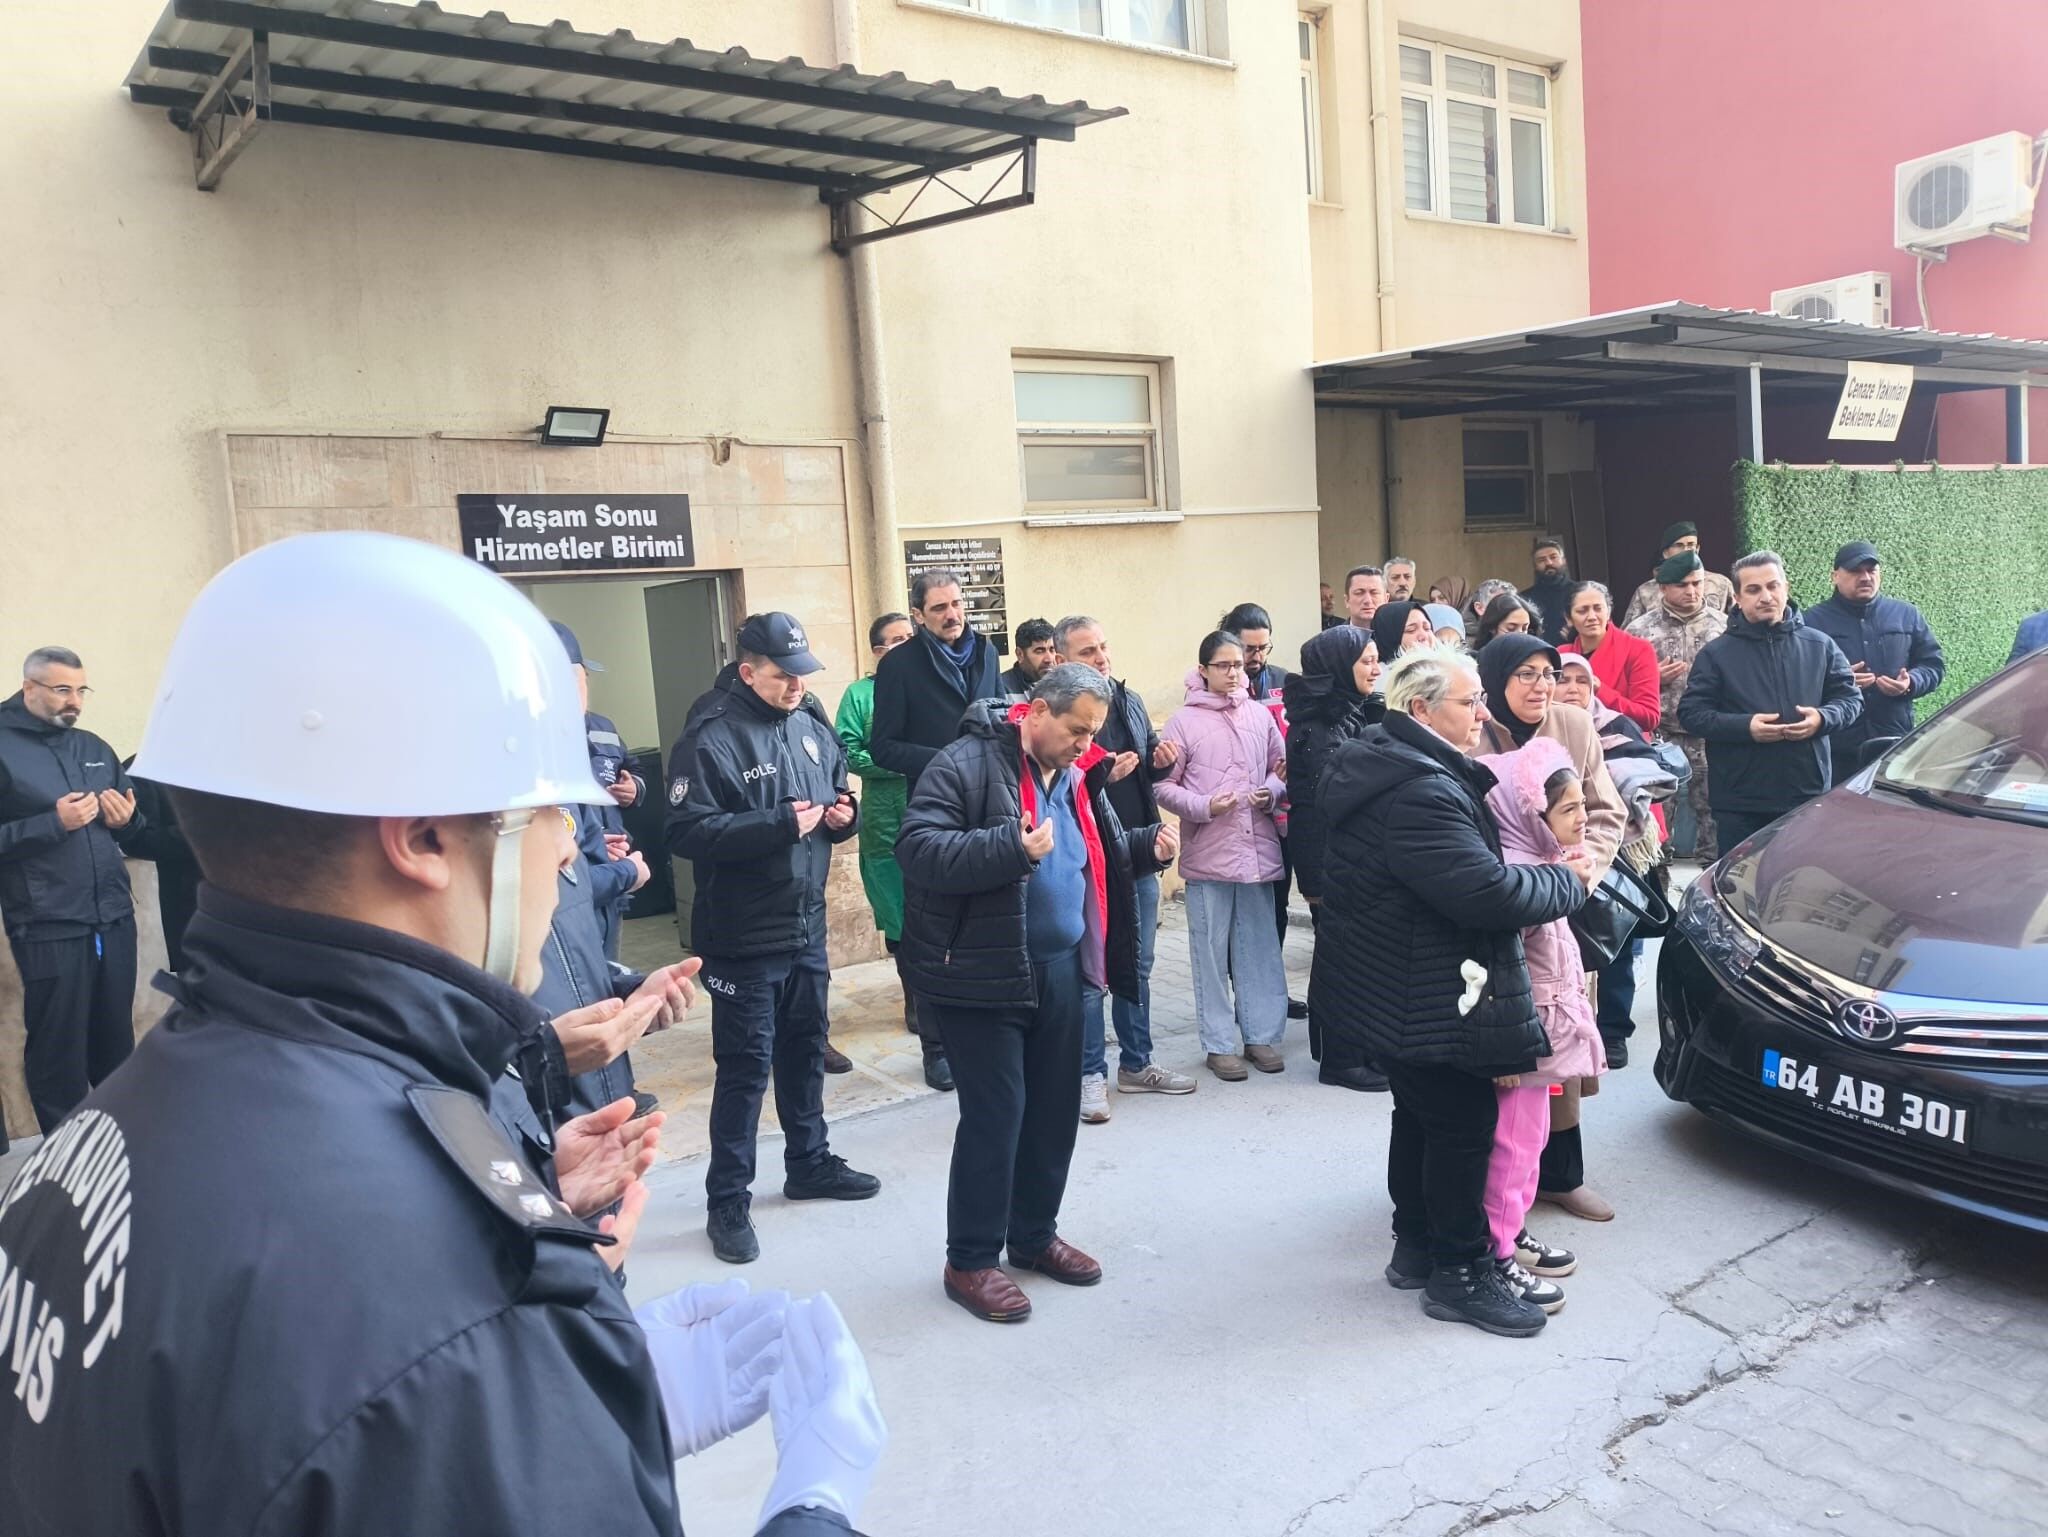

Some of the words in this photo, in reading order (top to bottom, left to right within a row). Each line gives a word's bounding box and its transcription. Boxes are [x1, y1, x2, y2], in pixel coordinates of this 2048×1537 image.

[1847, 376, 1876, 399] Cenaze
[1838, 405, 1876, 427] Bekleme
[496, 504, 587, 534] Yaşam
[594, 504, 658, 527] Sonu
[474, 536, 604, 562] Hizmetler
[611, 535, 685, 558] Birimi
[1764, 1069, 1776, 1080] TR
[1778, 1057, 1819, 1098] 64
[1830, 1074, 1885, 1118] AB
[1900, 1092, 1967, 1144] 301
